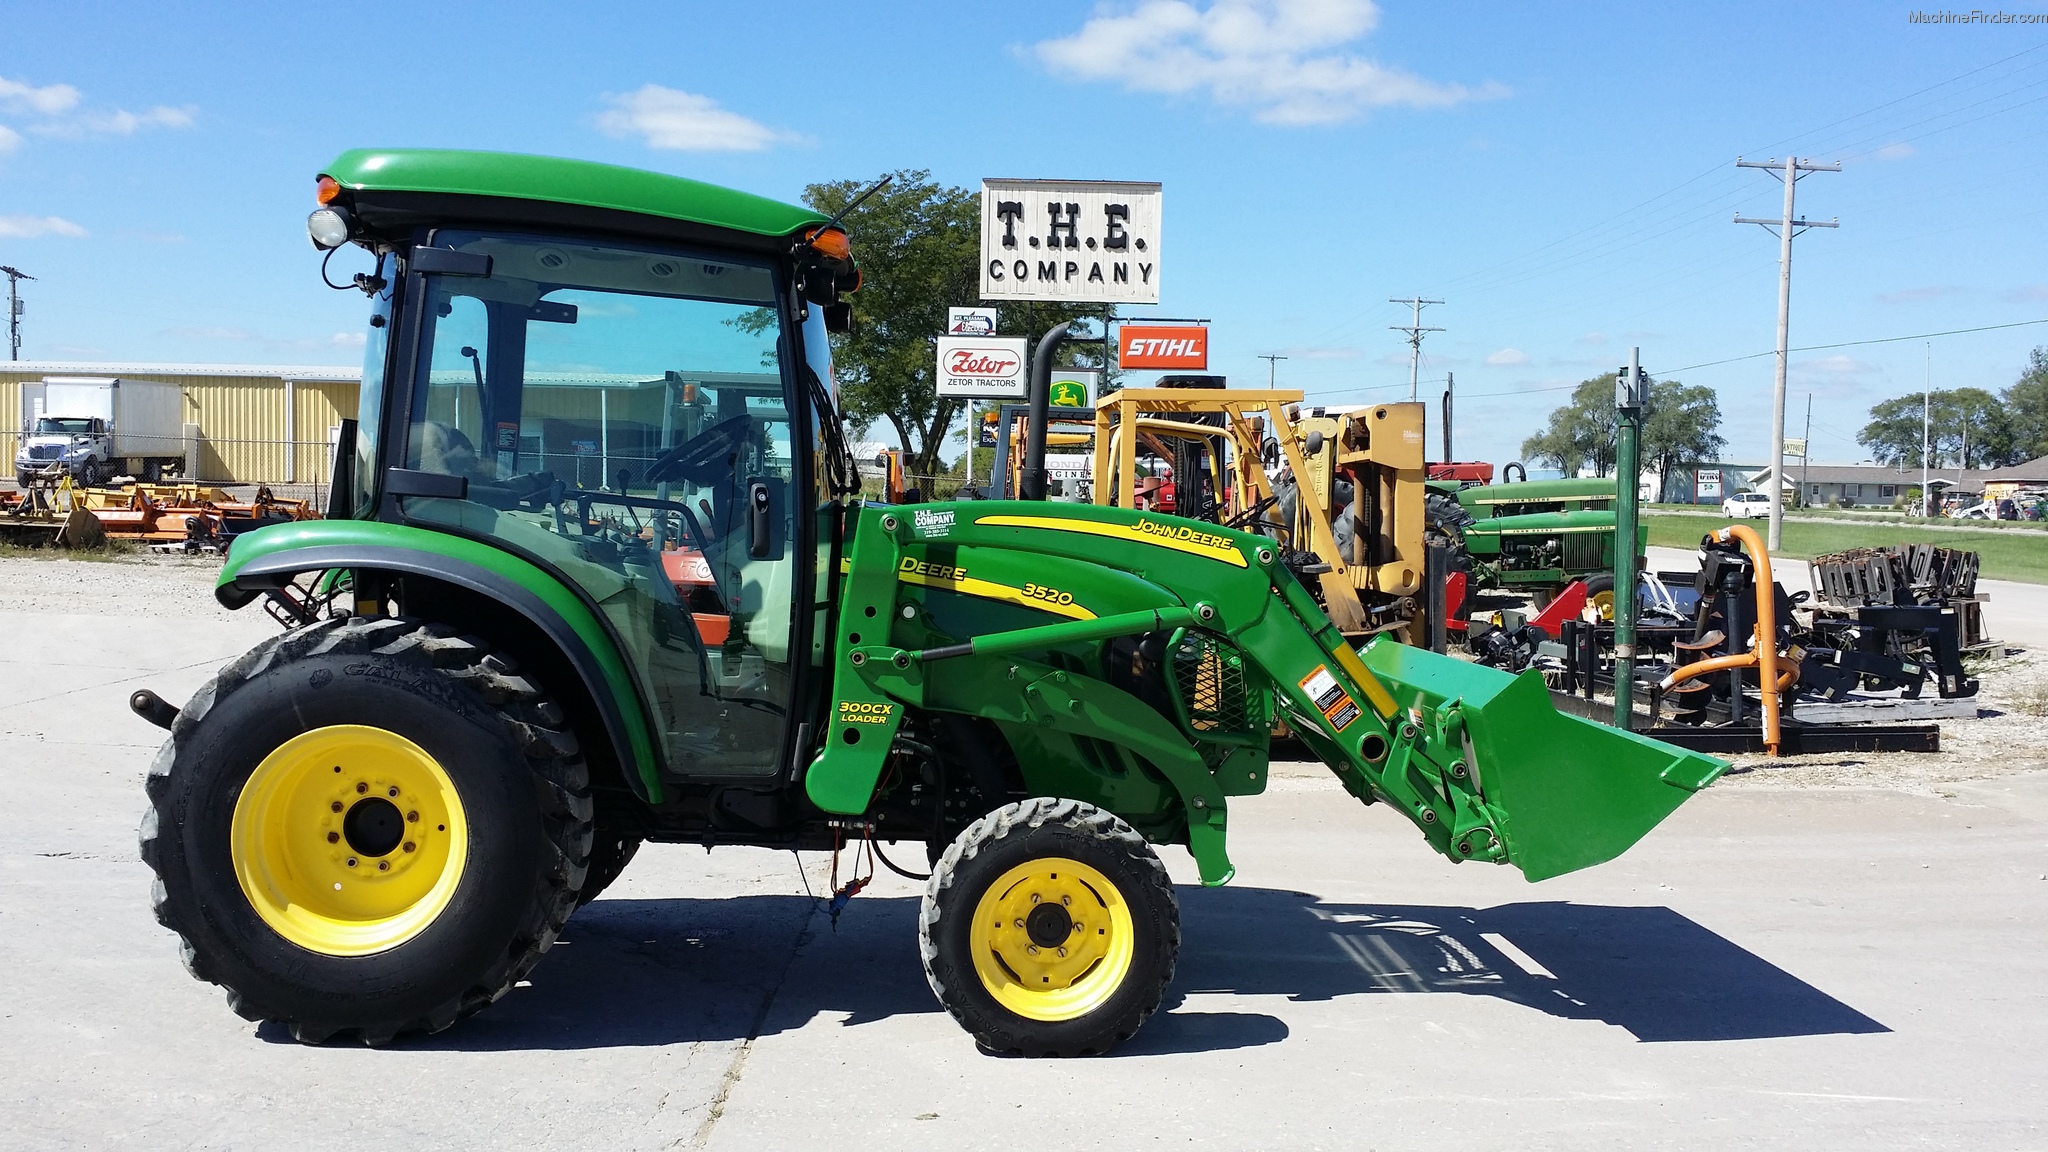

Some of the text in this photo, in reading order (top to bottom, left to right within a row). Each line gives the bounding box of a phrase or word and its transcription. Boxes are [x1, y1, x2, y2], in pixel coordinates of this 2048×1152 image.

[997, 201, 1147, 249] T.H.E.
[989, 259, 1153, 284] COMPANY
[1126, 338, 1201, 357] STIHL
[952, 350, 1016, 374] Zetor
[948, 378, 1017, 388] ZETOR TRACTORS
[915, 514, 955, 526] COMPANY
[900, 557, 967, 581] DEERE
[1022, 582, 1074, 606] 3520
[839, 702, 893, 714] 300CX
[841, 714, 888, 724] LOADER
